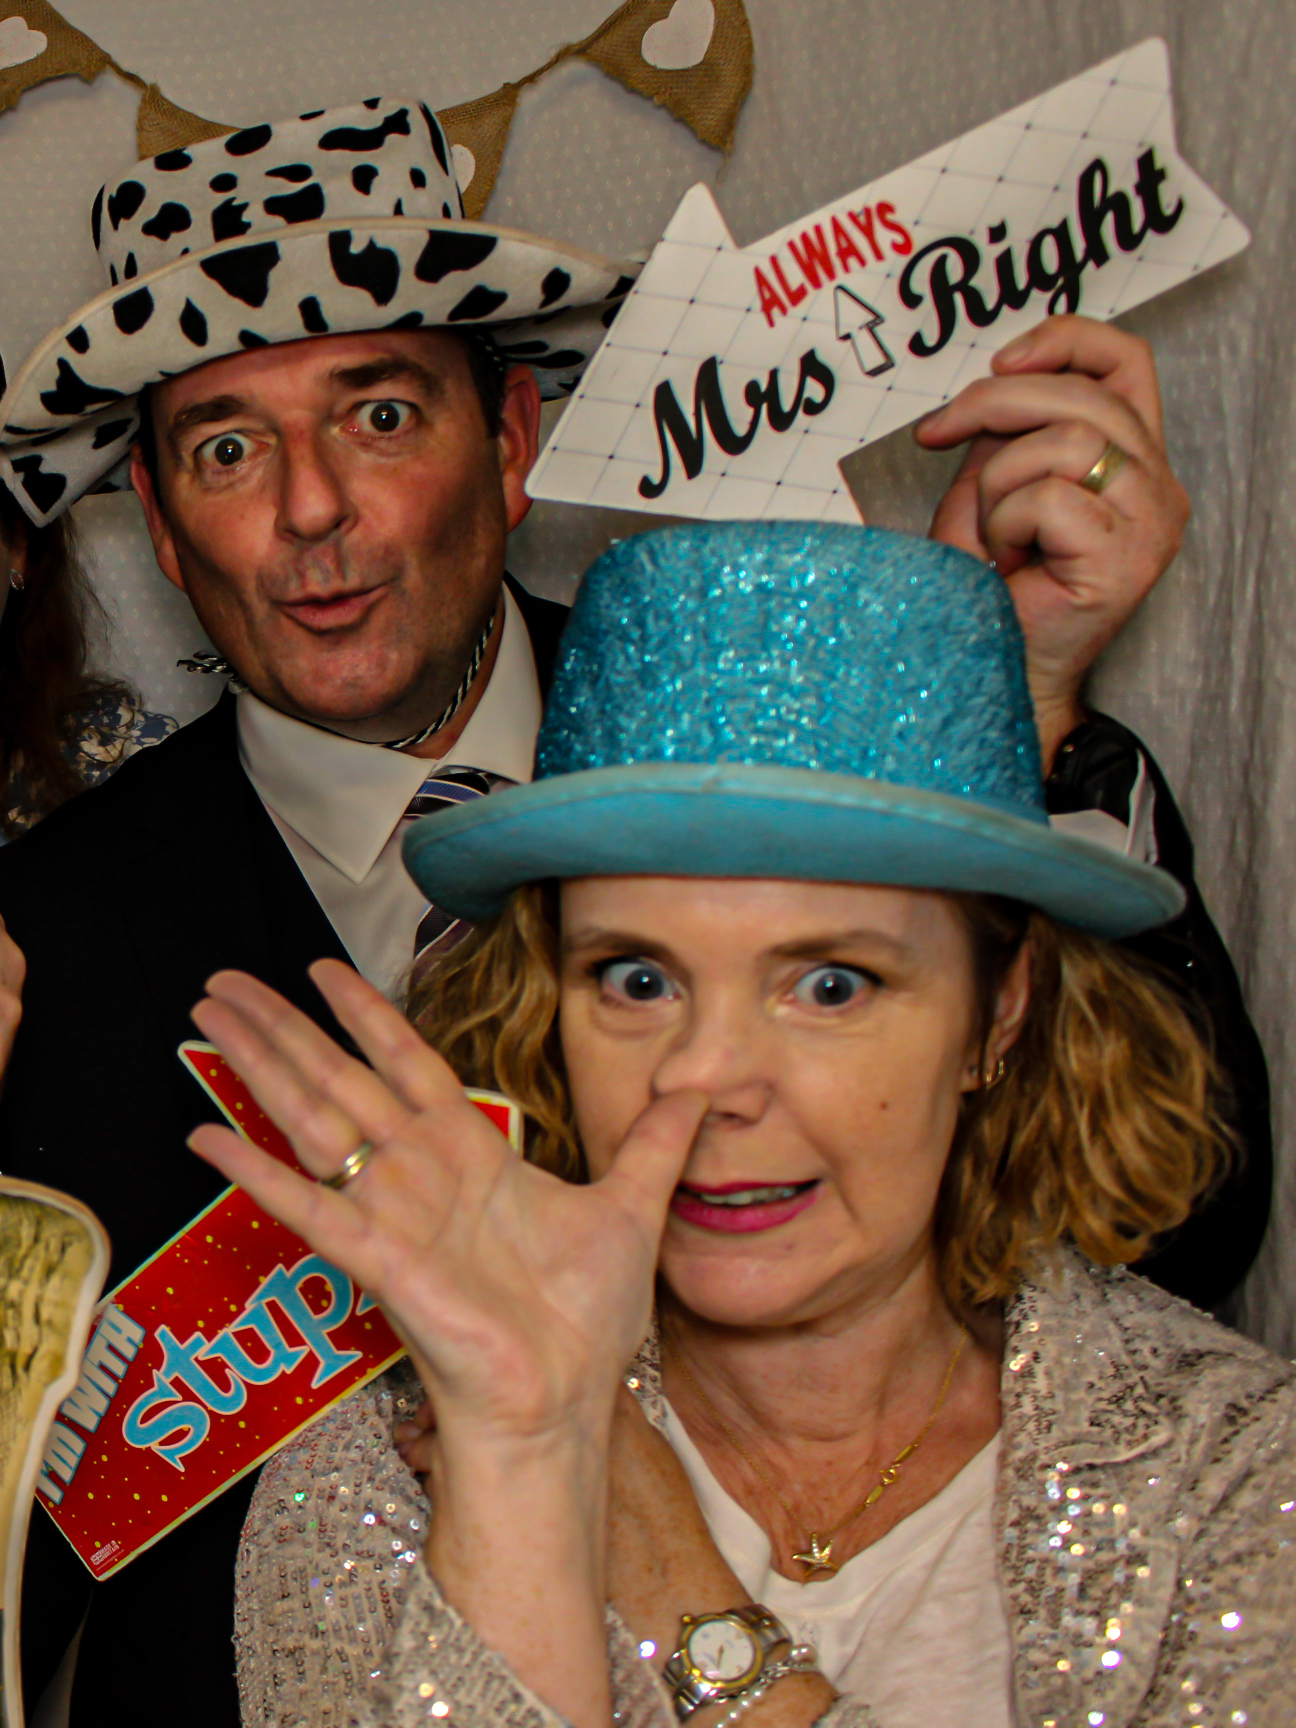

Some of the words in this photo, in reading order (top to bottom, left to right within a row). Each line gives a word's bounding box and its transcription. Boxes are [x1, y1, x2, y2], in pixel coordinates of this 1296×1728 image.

[638, 349, 836, 499] Mrs
[899, 148, 1184, 358] Right
[753, 200, 915, 328] ALWAYS
[59, 1303, 146, 1434] WITH
[122, 1252, 380, 1472] stup
